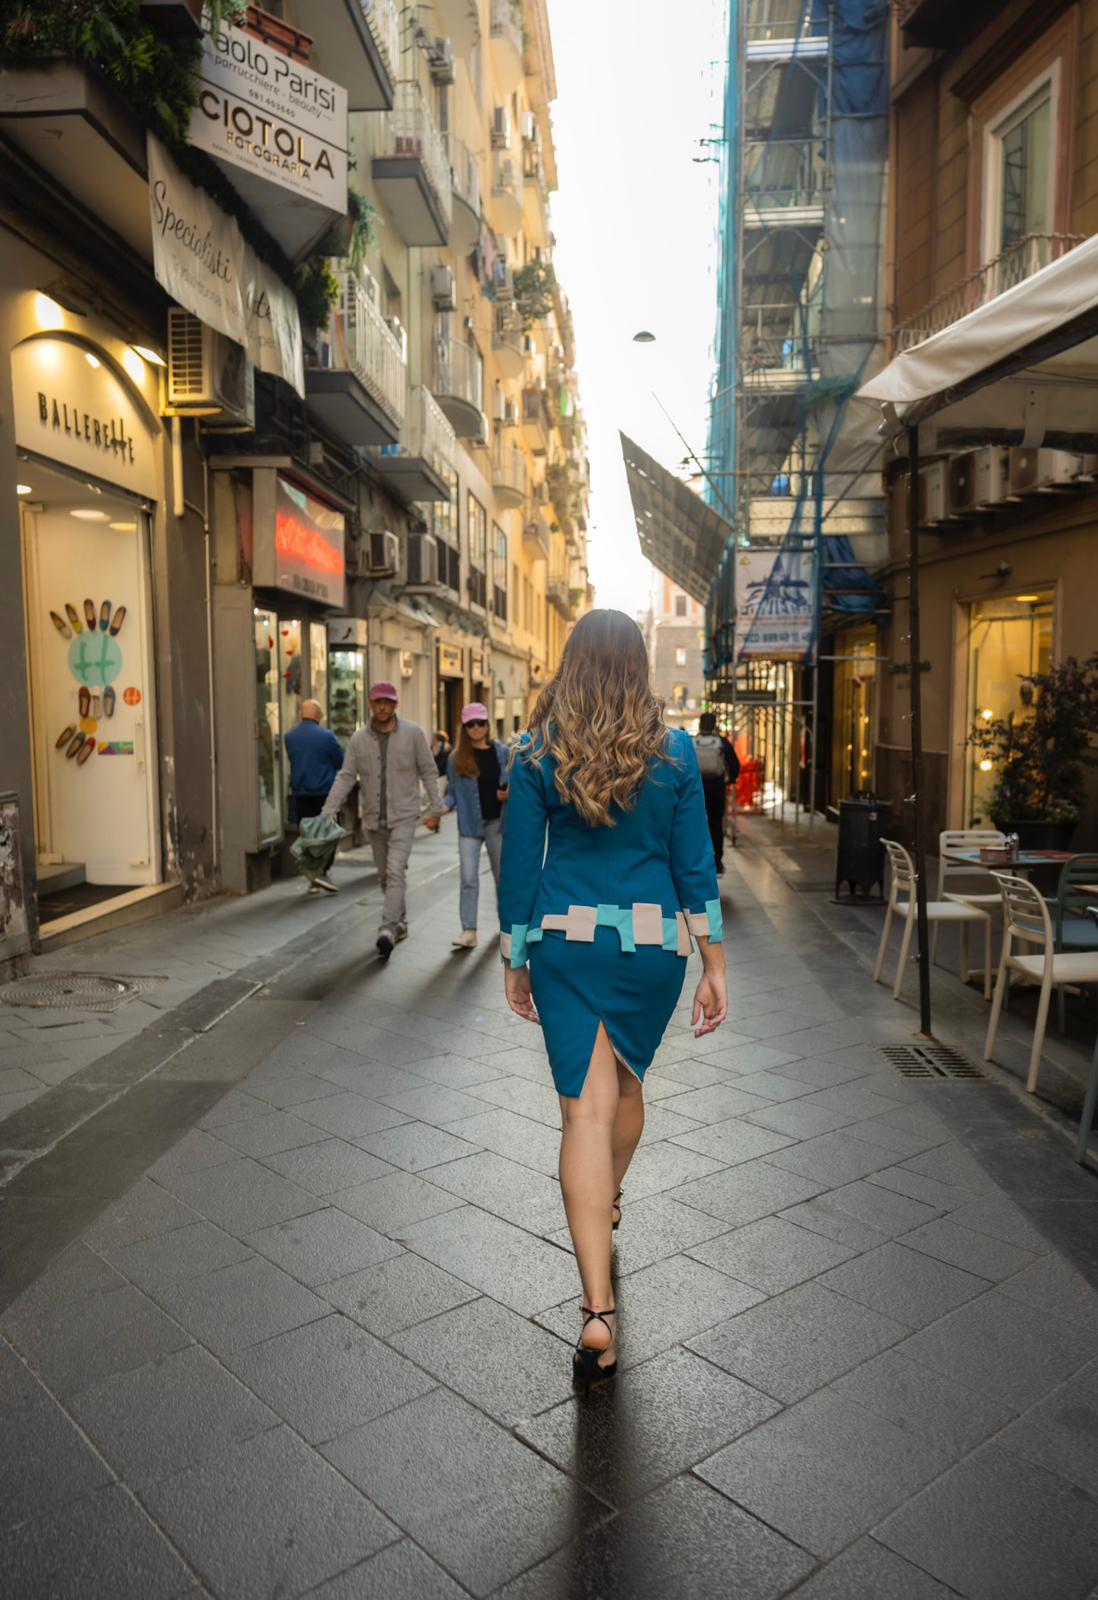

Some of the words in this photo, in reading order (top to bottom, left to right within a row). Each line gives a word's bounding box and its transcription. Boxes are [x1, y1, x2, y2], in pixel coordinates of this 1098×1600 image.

[214, 54, 280, 95] parrucchiere
[288, 91, 322, 119] beauty
[274, 56, 336, 113] Parisi
[200, 90, 335, 179] CIOTOLA
[226, 131, 311, 181] FOTOGRAFIA
[153, 180, 232, 283] Specialisti
